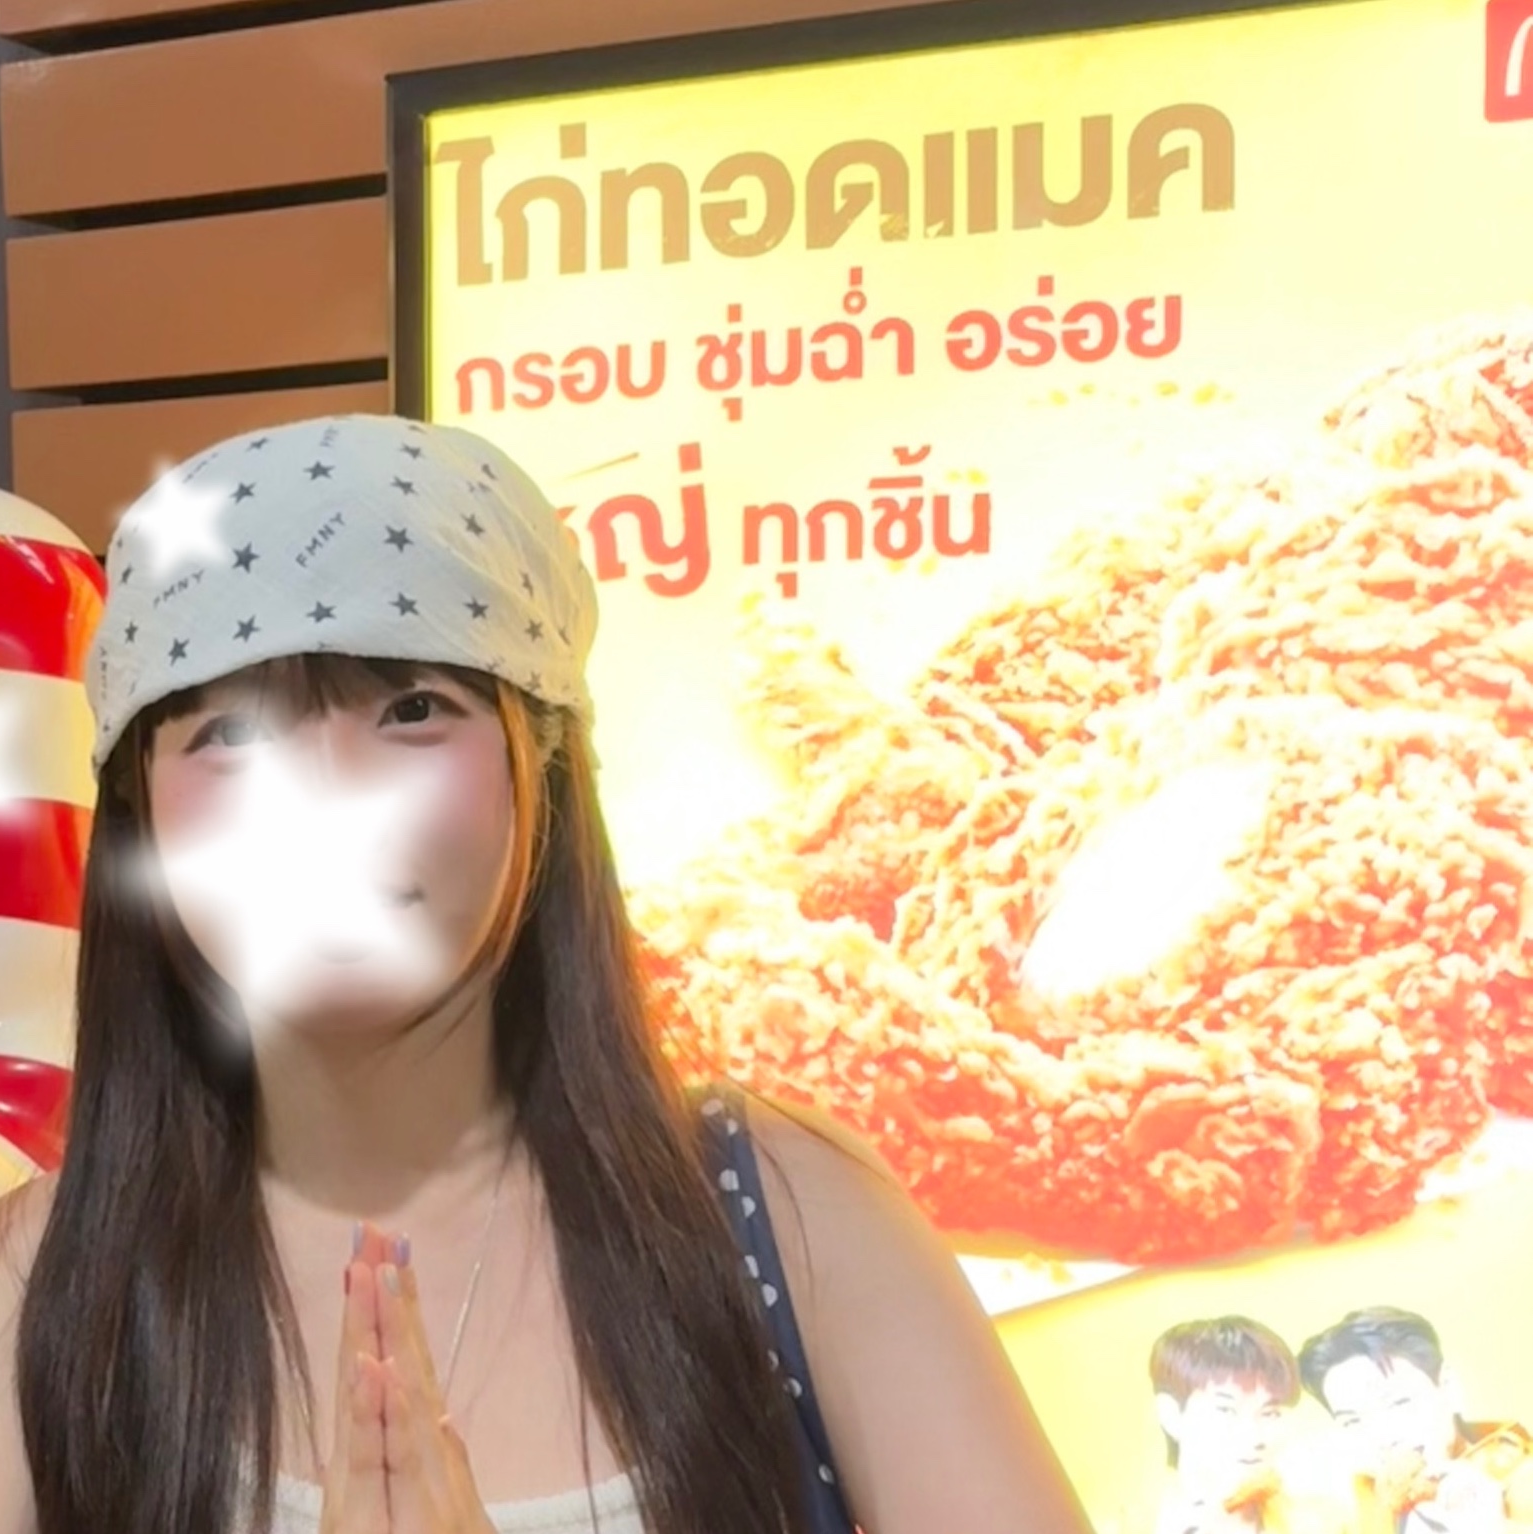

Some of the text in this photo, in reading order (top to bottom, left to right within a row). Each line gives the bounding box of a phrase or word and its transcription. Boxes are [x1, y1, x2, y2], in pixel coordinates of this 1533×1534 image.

[434, 102, 1235, 287] ไก่ทอดแมค
[455, 266, 1183, 422] กรอบ ชุ่มฉ่ำ อร่อย
[295, 511, 346, 569] FMNY
[742, 445, 992, 599] ทุกชิ้น
